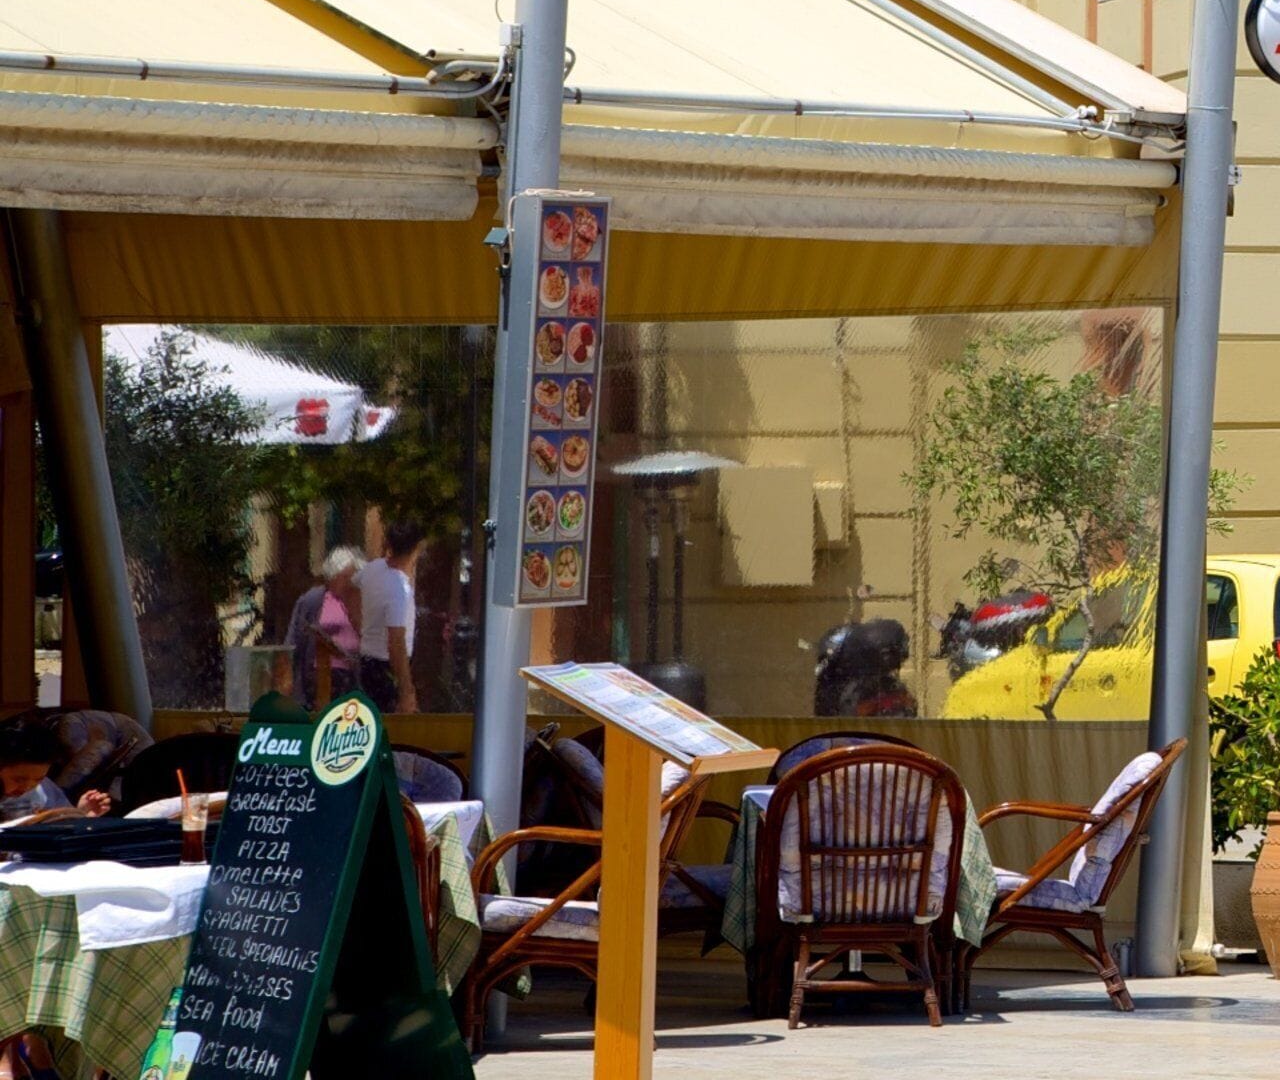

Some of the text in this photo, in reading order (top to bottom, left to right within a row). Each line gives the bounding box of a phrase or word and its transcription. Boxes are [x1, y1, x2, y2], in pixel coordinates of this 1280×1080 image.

[238, 727, 303, 763] Menu
[315, 721, 371, 765] Mythos
[247, 815, 293, 834] TOAST
[237, 840, 290, 862] PIZZA
[203, 909, 289, 937] SPAGHETTI
[180, 994, 215, 1022] SEA
